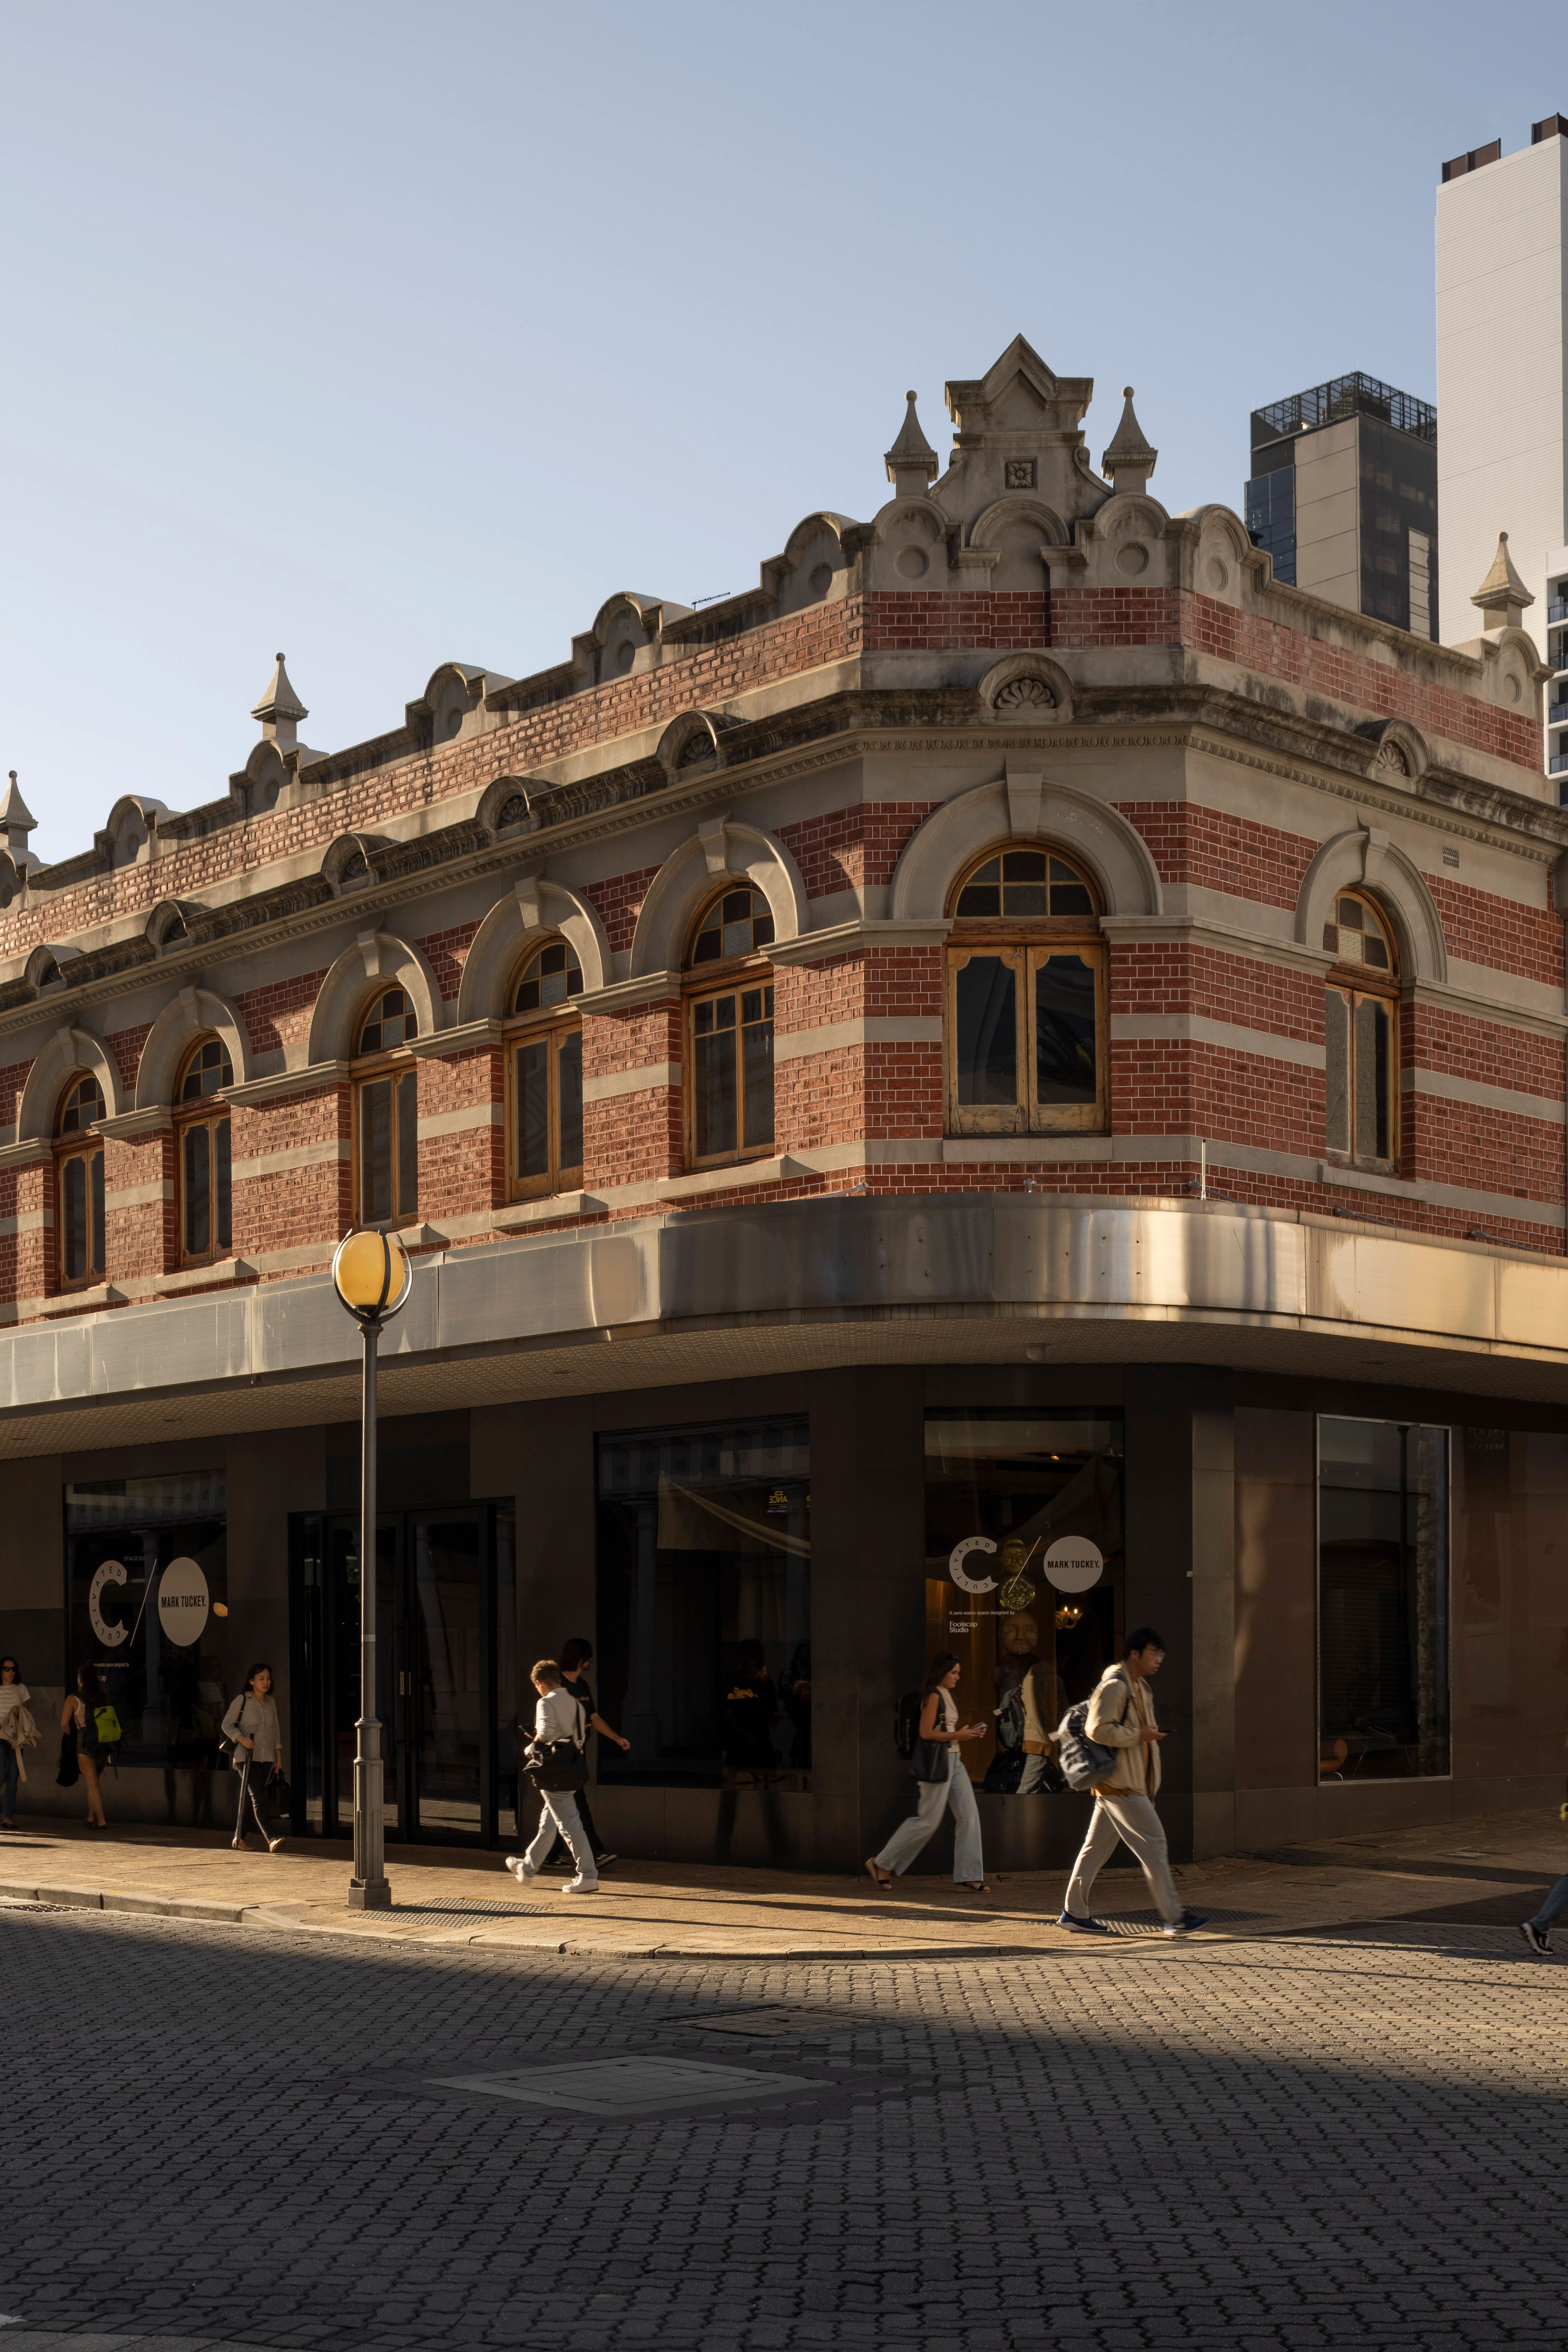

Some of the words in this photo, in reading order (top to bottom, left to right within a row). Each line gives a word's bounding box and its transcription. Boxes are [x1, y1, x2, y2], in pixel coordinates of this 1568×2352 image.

[953, 1540, 990, 1590] CULTIVATED
[92, 1566, 121, 1641] CULTIVATED
[161, 1597, 179, 1608] MARK
[181, 1595, 206, 1608] TUCKEY.
